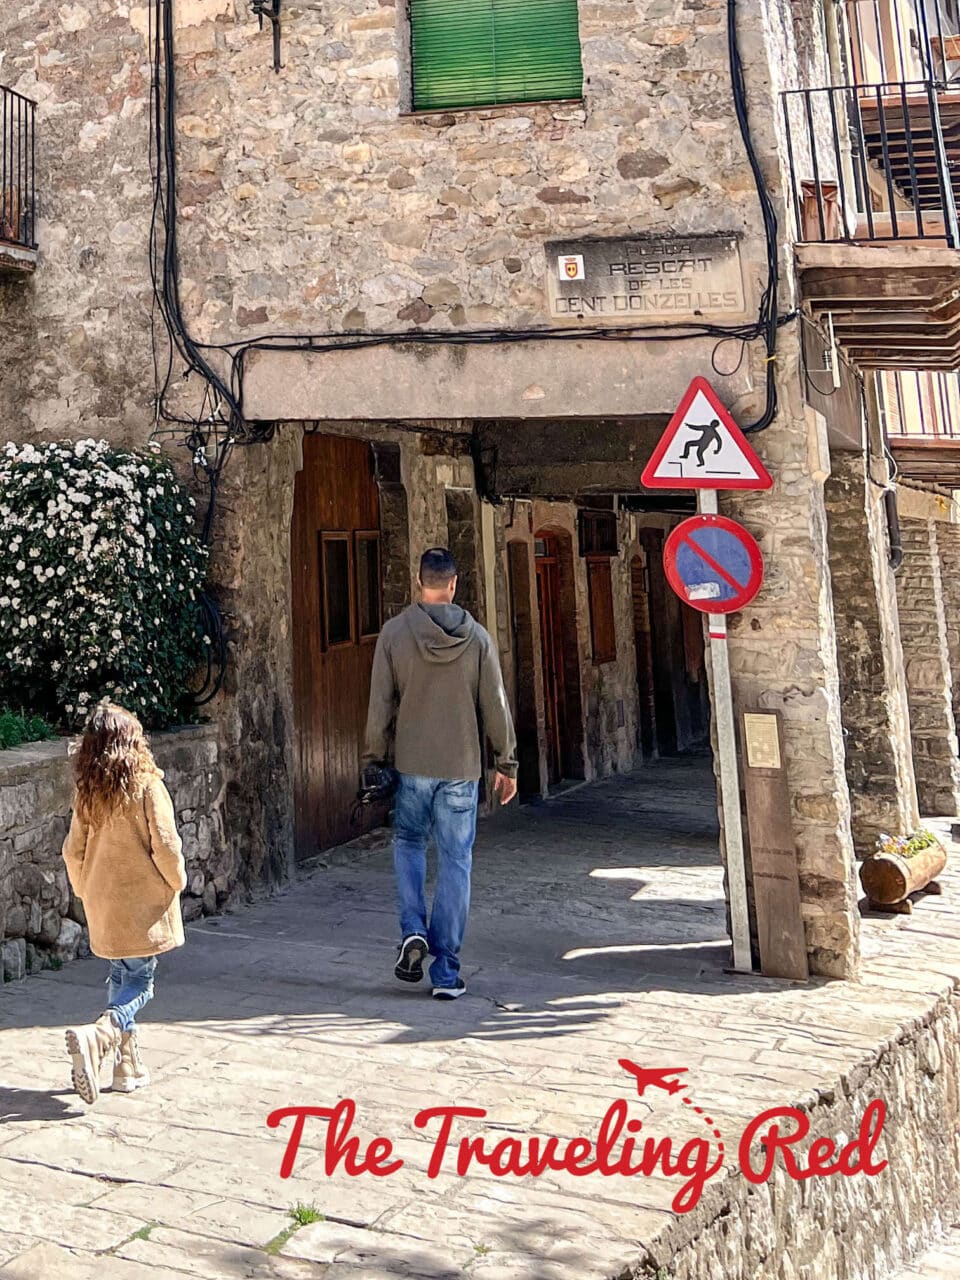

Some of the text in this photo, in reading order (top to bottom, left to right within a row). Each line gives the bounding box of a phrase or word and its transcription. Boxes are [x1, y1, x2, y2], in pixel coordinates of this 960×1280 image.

[609, 258, 713, 276] RESCAT
[629, 277, 692, 291] DE LES
[555, 292, 738, 313] CENT DONZELLES
